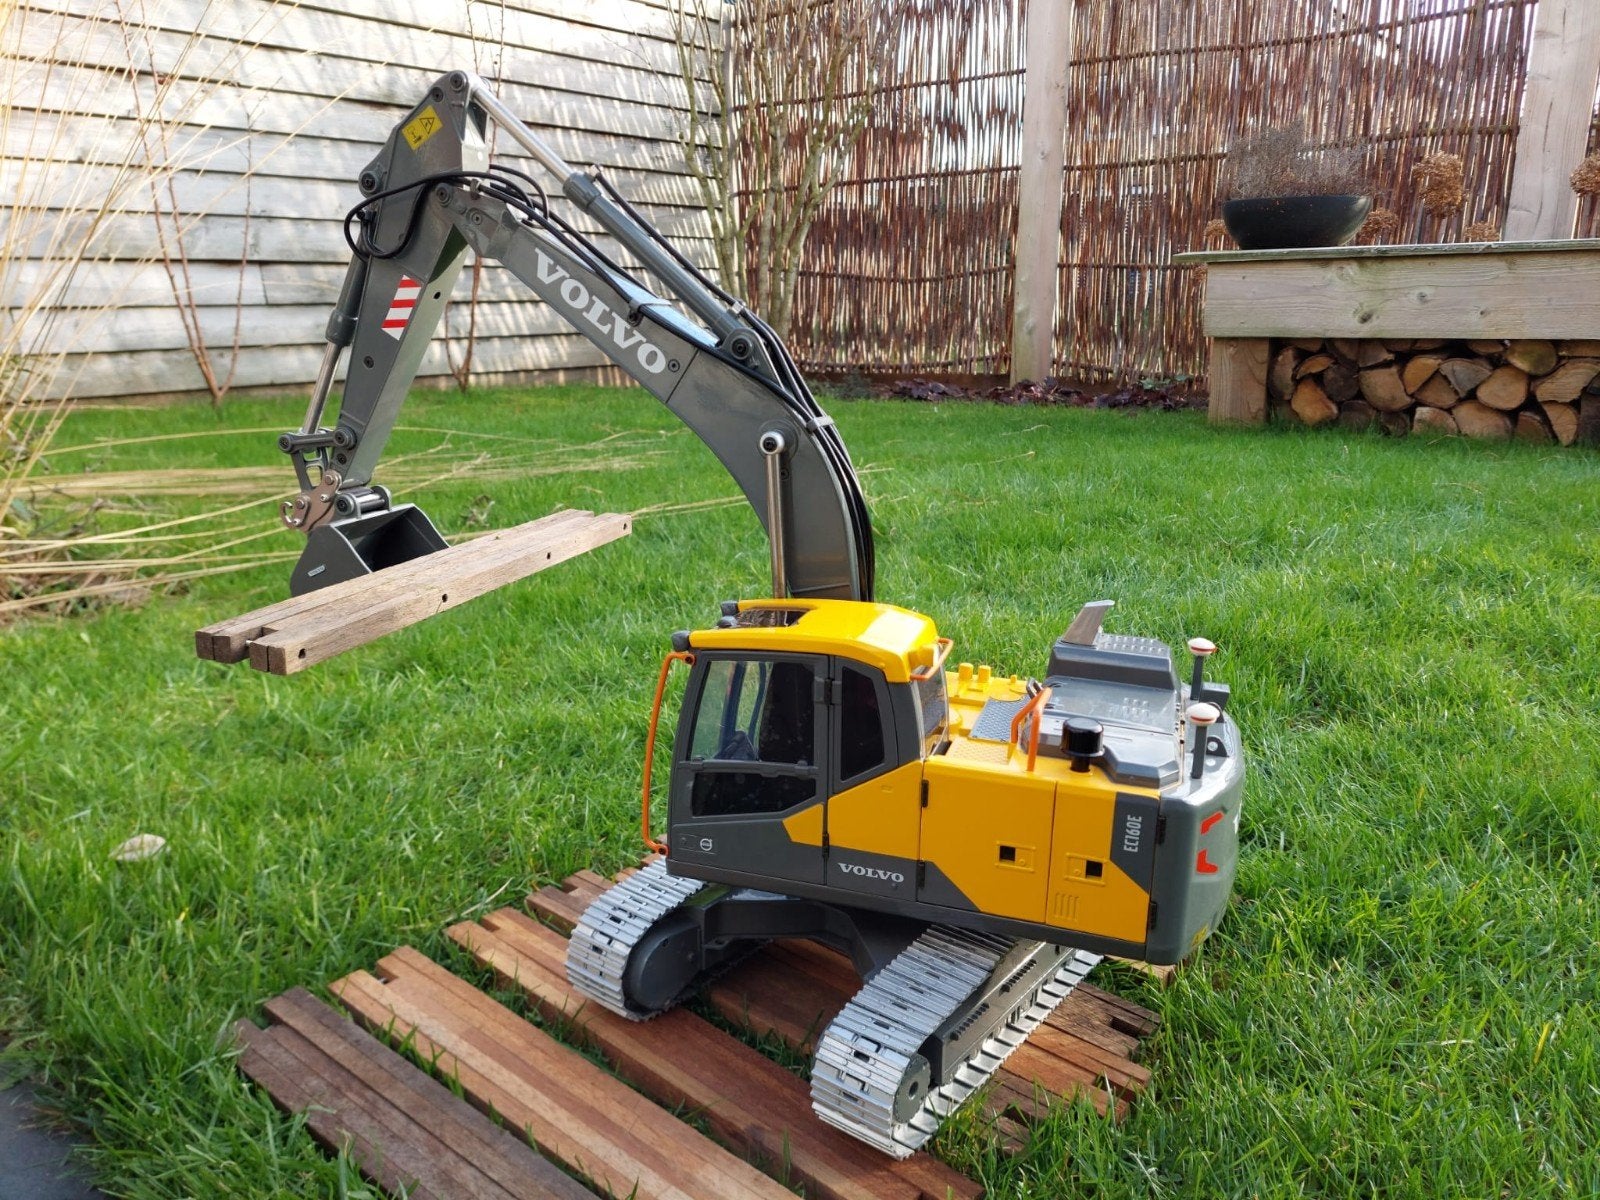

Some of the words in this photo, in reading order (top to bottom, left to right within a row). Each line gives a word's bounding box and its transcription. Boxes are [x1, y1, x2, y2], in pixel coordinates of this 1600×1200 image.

[535, 248, 666, 373] VOLVO
[1124, 815, 1142, 852] EC160E
[838, 862, 904, 882] VOLVO
